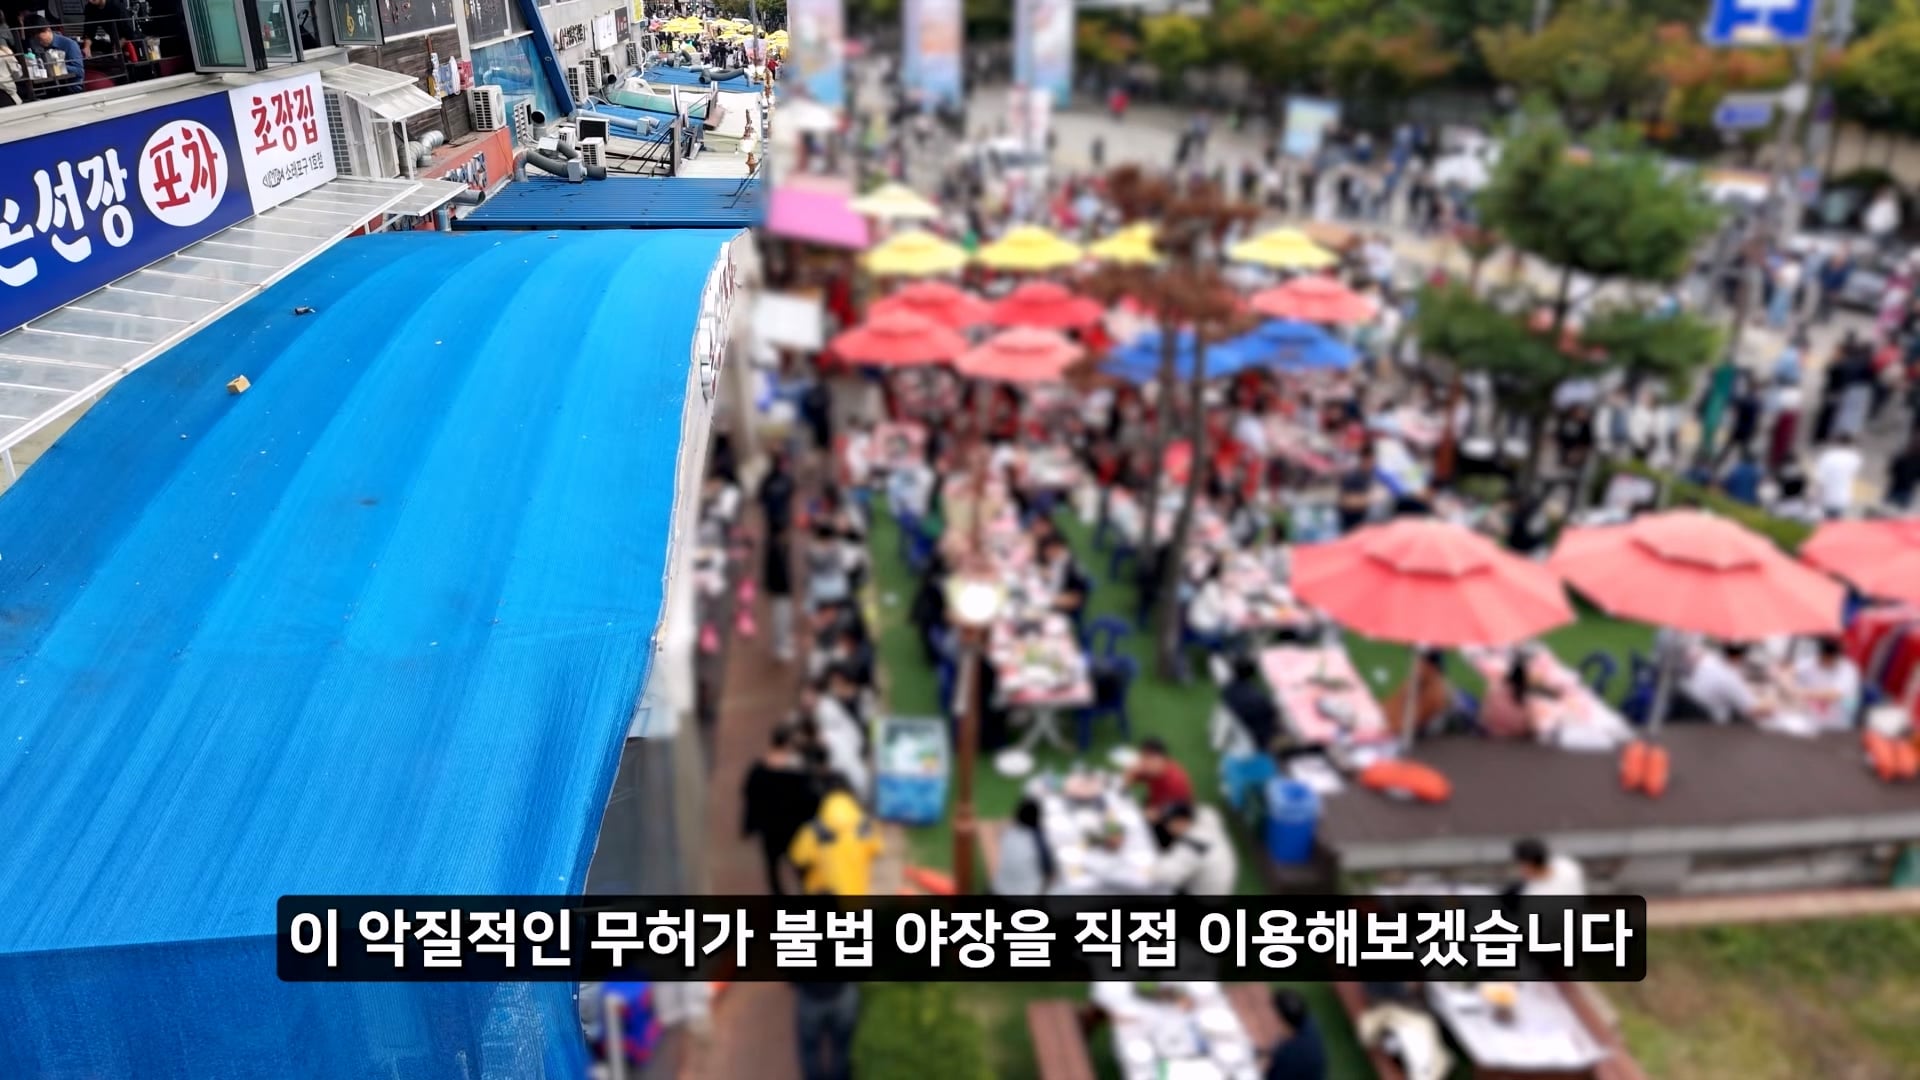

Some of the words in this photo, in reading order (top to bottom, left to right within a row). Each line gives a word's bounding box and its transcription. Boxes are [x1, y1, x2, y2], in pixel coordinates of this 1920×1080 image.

[251, 85, 318, 156] 초장집
[149, 127, 218, 211] 포차
[285, 157, 309, 181] 소래포구
[308, 151, 324, 171] 1호점
